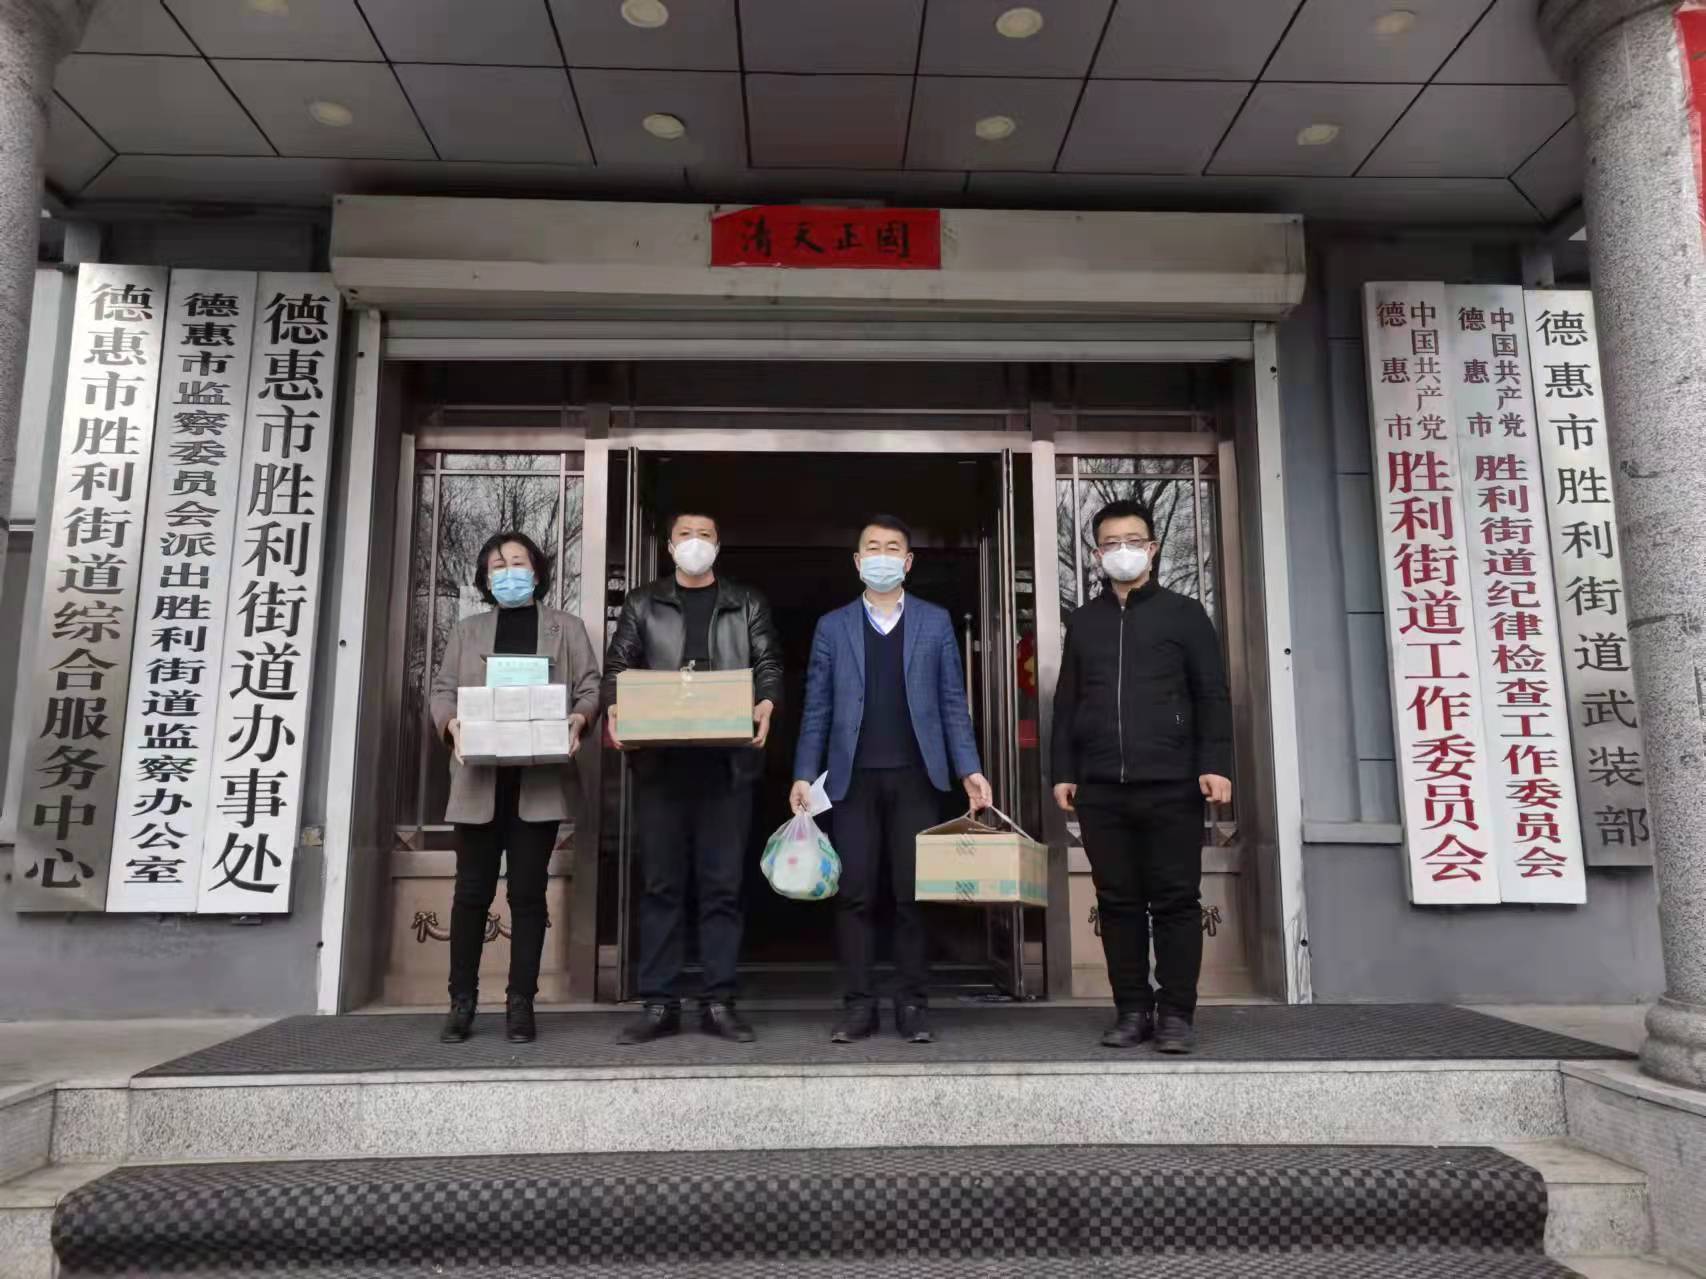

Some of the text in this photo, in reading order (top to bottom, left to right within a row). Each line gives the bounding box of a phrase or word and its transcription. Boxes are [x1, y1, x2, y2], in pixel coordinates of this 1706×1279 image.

[25, 283, 154, 889] 德惠市胜利街道综合服务中心
[123, 292, 239, 885] 德惠市监察委员会派出胜利街道监察办公室
[208, 292, 331, 893] 德惠市胜利街道办事处
[1388, 451, 1489, 883] 胜利街道工作委员会
[1473, 453, 1568, 879] 胜利街道纪律检查工作委员会
[1535, 310, 1650, 848] 德惠市胜利街道武装部
